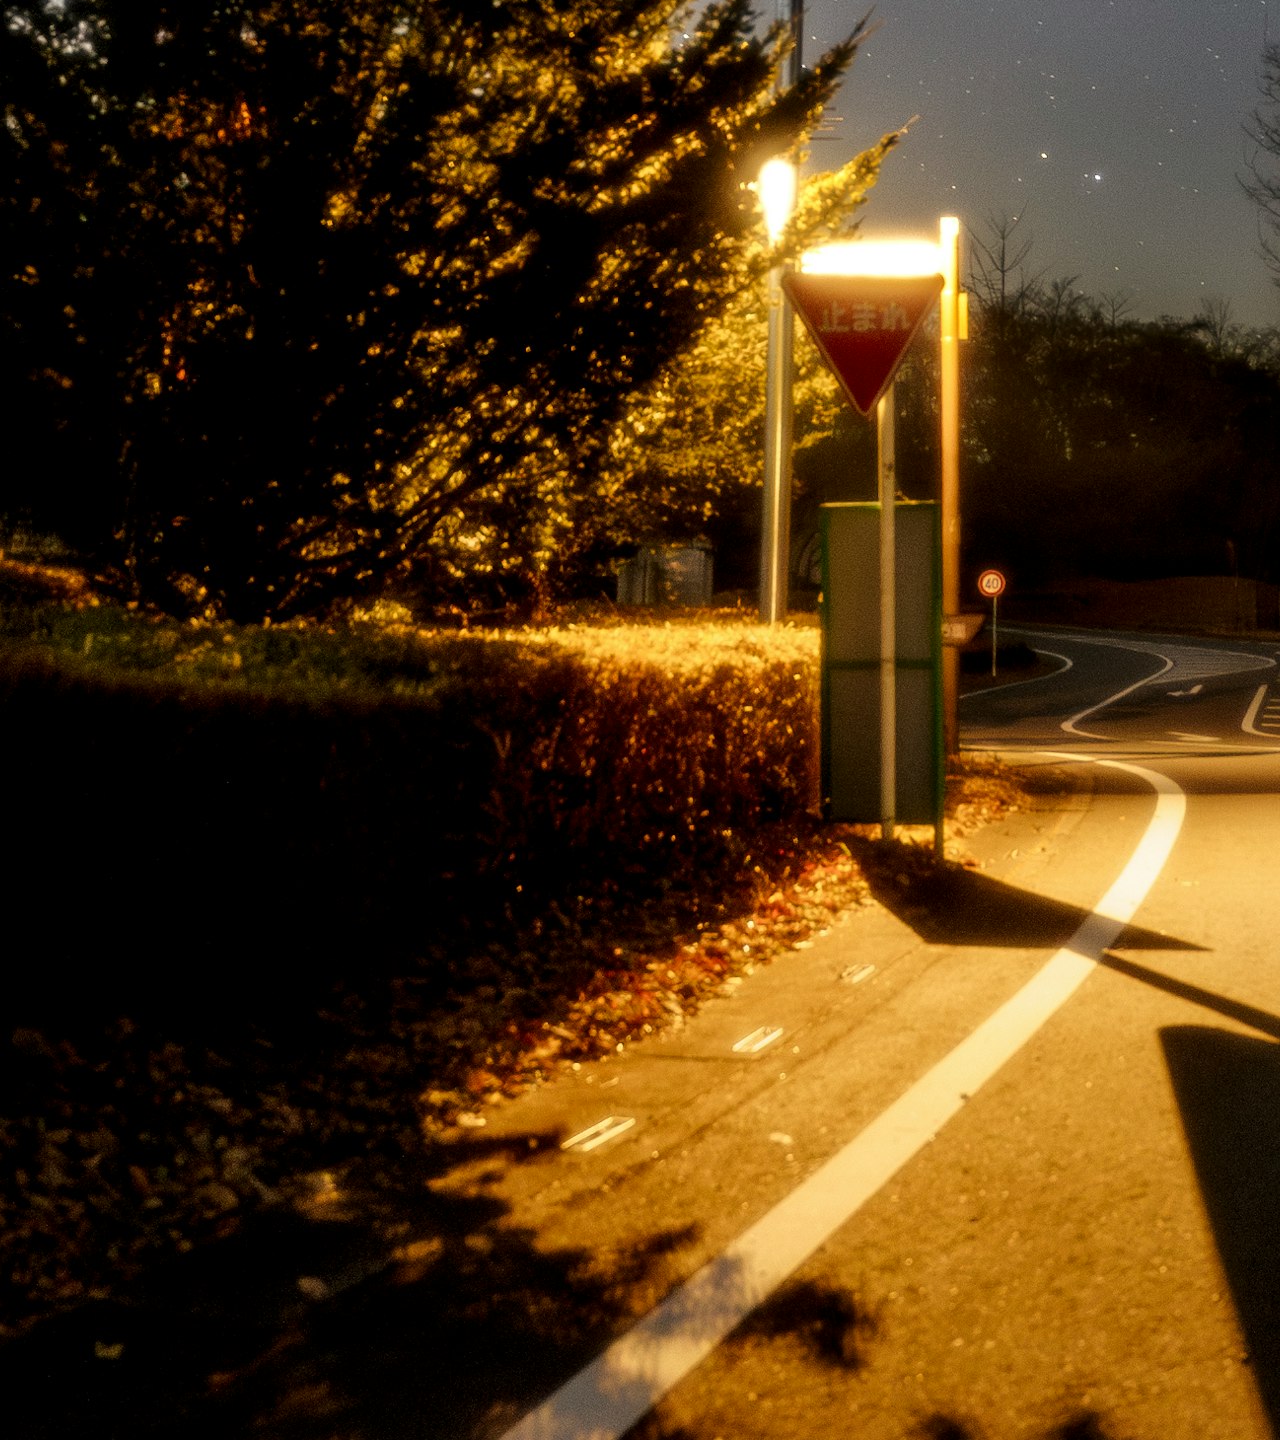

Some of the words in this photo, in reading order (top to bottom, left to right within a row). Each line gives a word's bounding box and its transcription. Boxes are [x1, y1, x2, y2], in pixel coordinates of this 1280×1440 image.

[820, 299, 913, 333] 止まれ
[985, 577, 999, 589] 40
